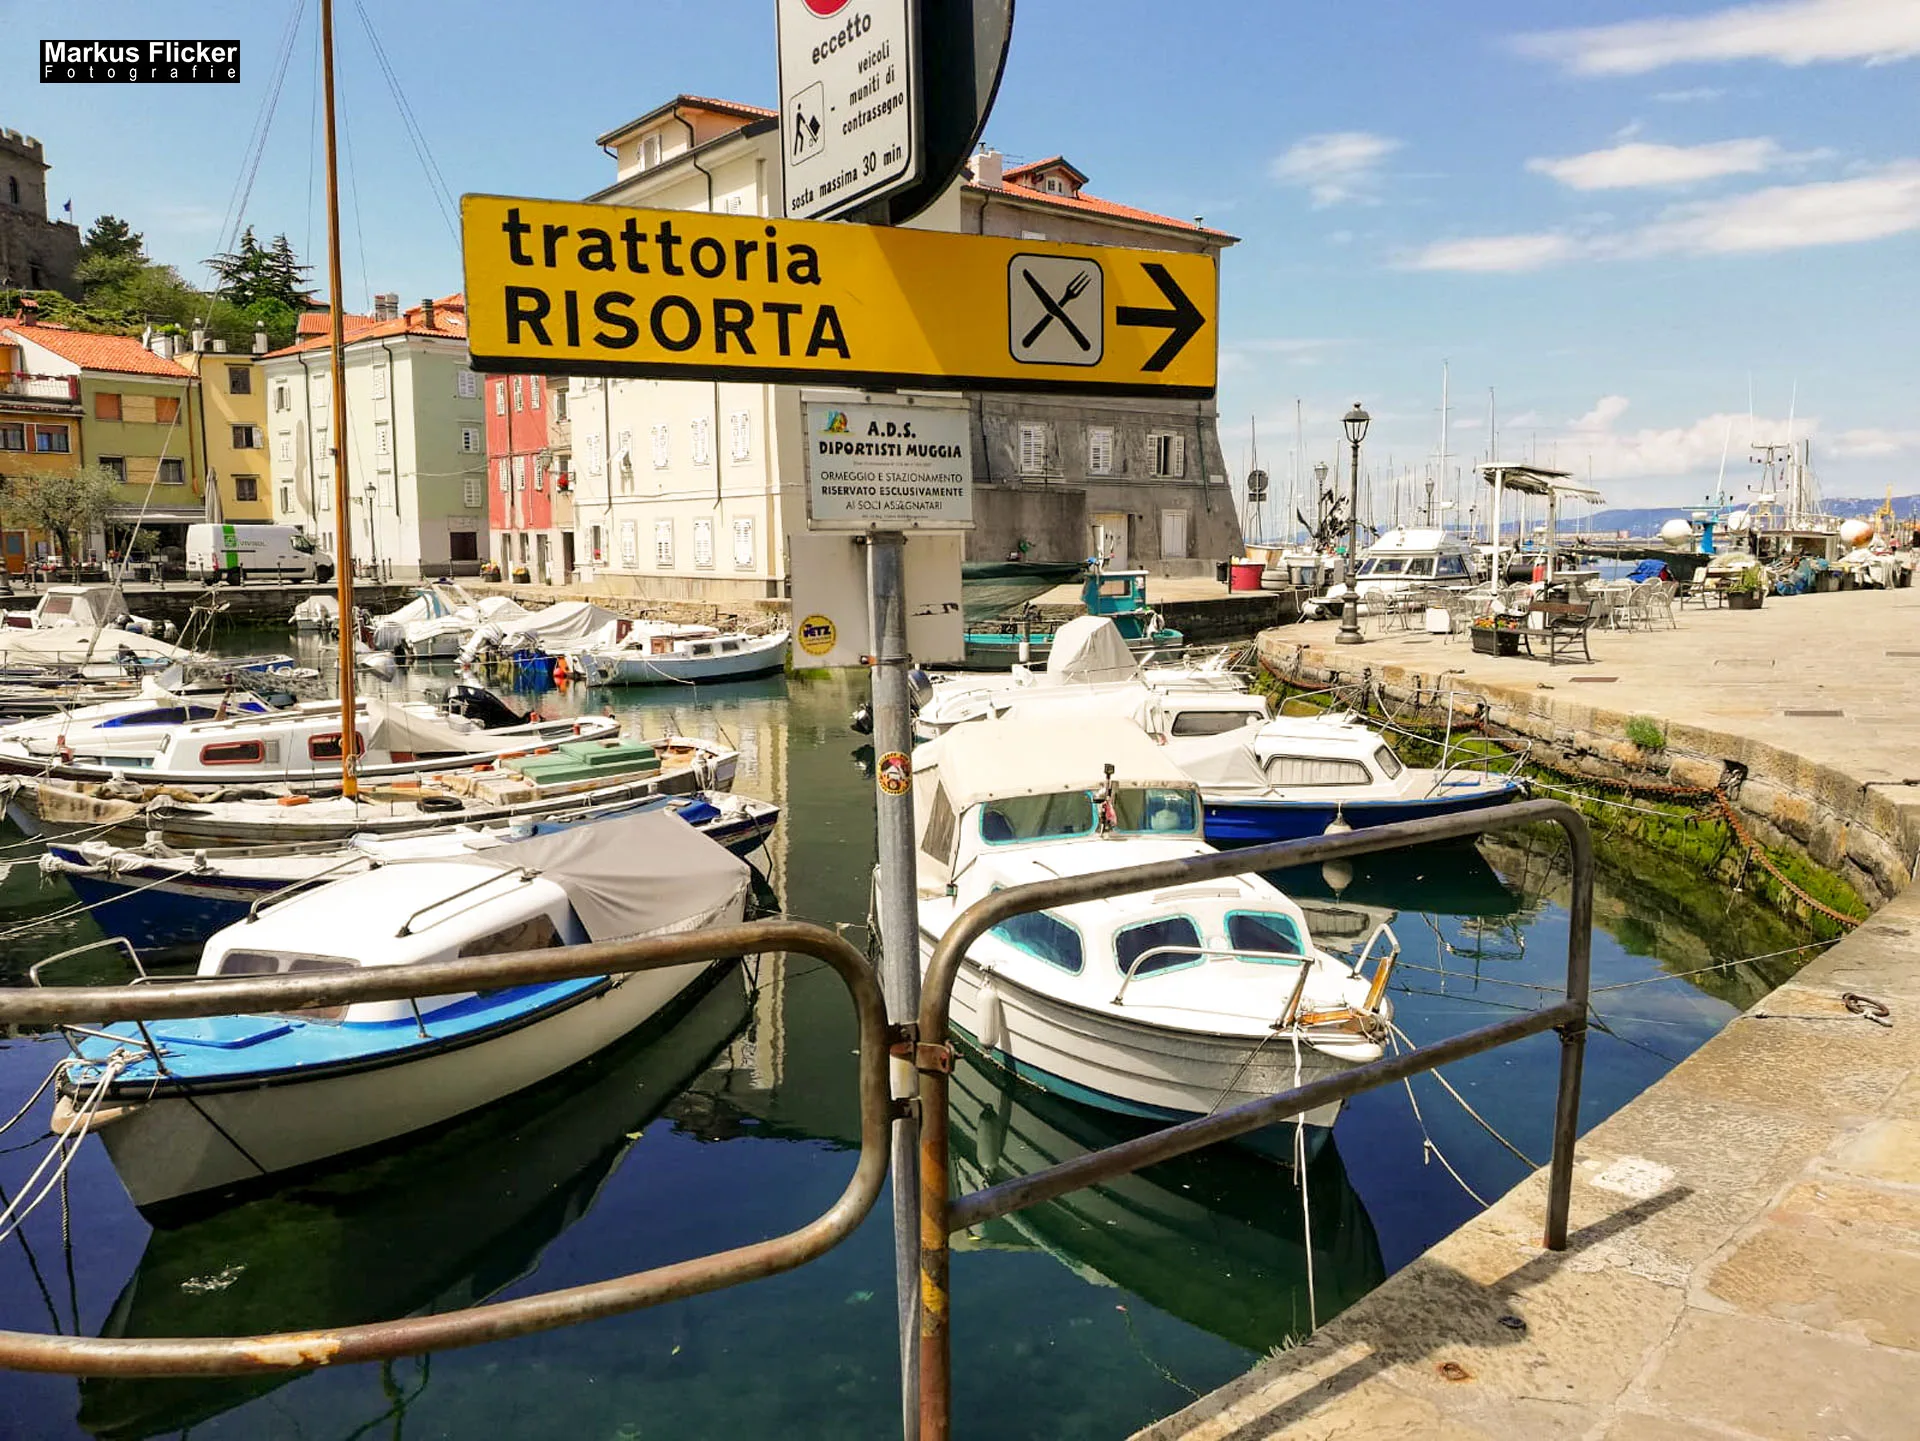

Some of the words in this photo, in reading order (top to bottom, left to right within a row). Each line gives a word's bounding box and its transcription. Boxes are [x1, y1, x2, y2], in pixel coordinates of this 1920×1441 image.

[811, 12, 872, 65] eccetto
[857, 40, 891, 74] veicoli
[849, 73, 881, 106] muniti
[885, 66, 895, 86] di
[842, 91, 904, 136] contrassegno
[791, 187, 814, 211] sosta
[819, 168, 858, 198] massima
[862, 151, 877, 177] 30
[883, 144, 902, 167] min
[502, 208, 821, 286] trattoria
[505, 285, 851, 359] RISORTA
[867, 421, 917, 439] A.D.S.
[819, 441, 901, 457] DIPORTISTI
[906, 445, 962, 458] MUGGIA
[820, 471, 876, 482] ORMEGGIO
[878, 472, 884, 481] E
[885, 472, 963, 484] STAZIONAMENTO
[821, 485, 877, 496] RISERVATO
[879, 487, 964, 497] ESCLUSIVAMENTE
[846, 501, 854, 510] AI
[858, 501, 881, 510] SOCI
[883, 501, 943, 511] ASSEGNATARI
